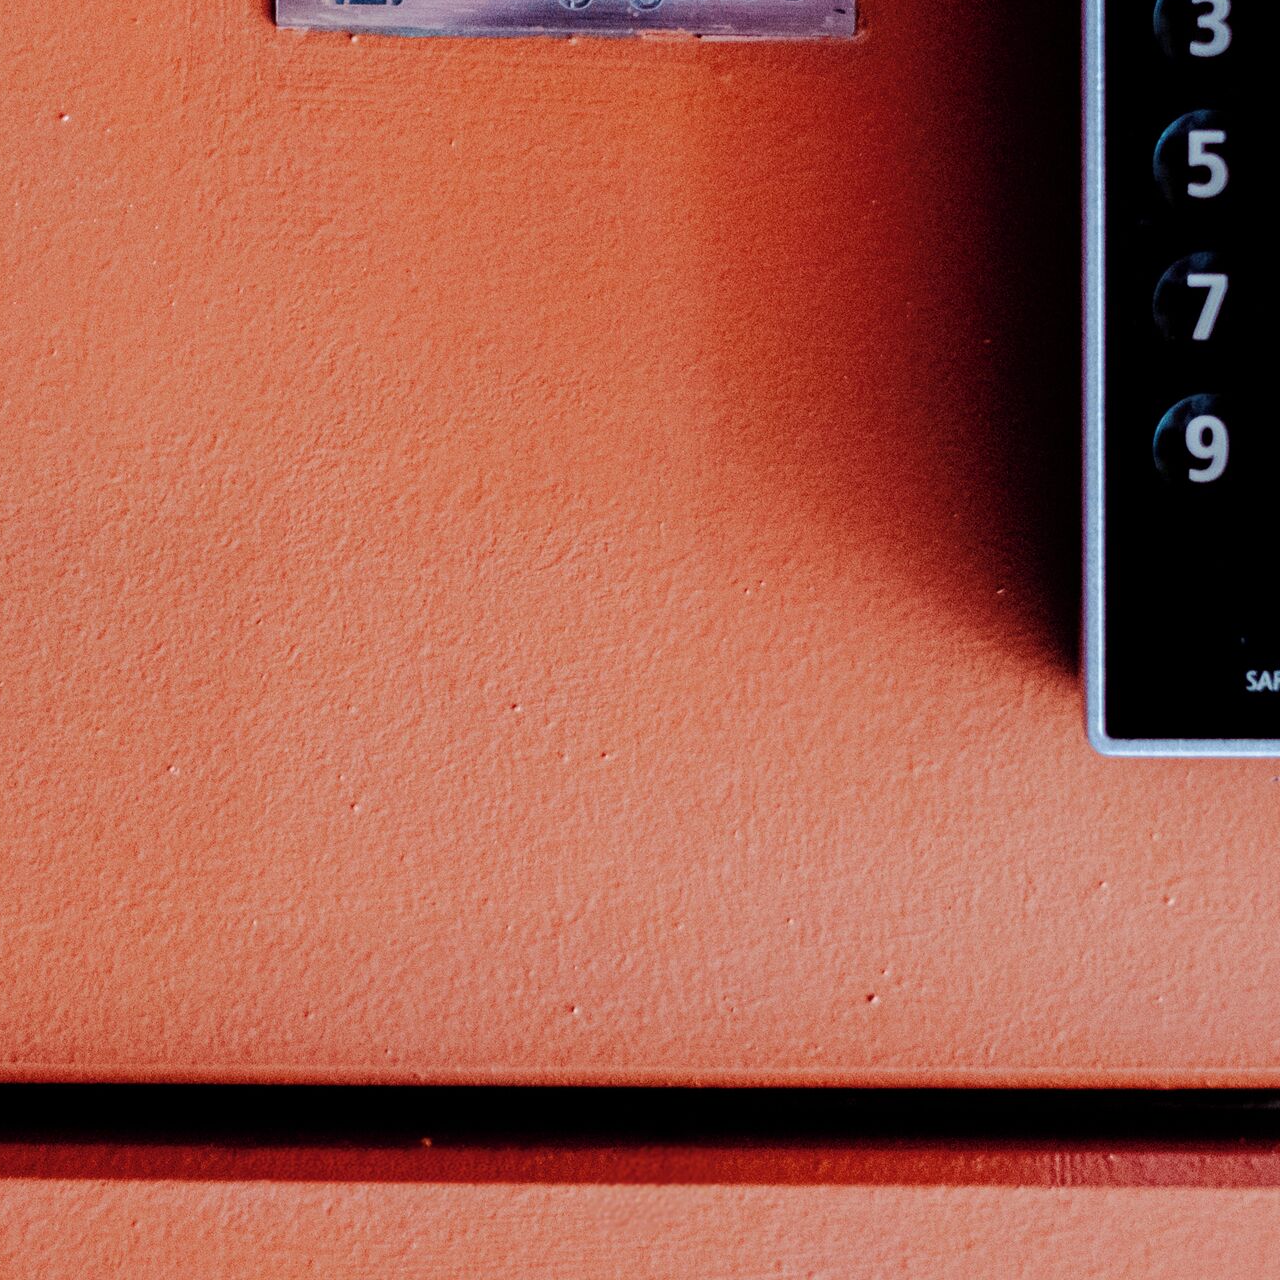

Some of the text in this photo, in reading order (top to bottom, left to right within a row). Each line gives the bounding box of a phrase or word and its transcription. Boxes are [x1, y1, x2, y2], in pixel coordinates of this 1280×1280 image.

[1188, 130, 1227, 197] 5
[1187, 274, 1227, 340] 7
[1186, 415, 1228, 482] 9
